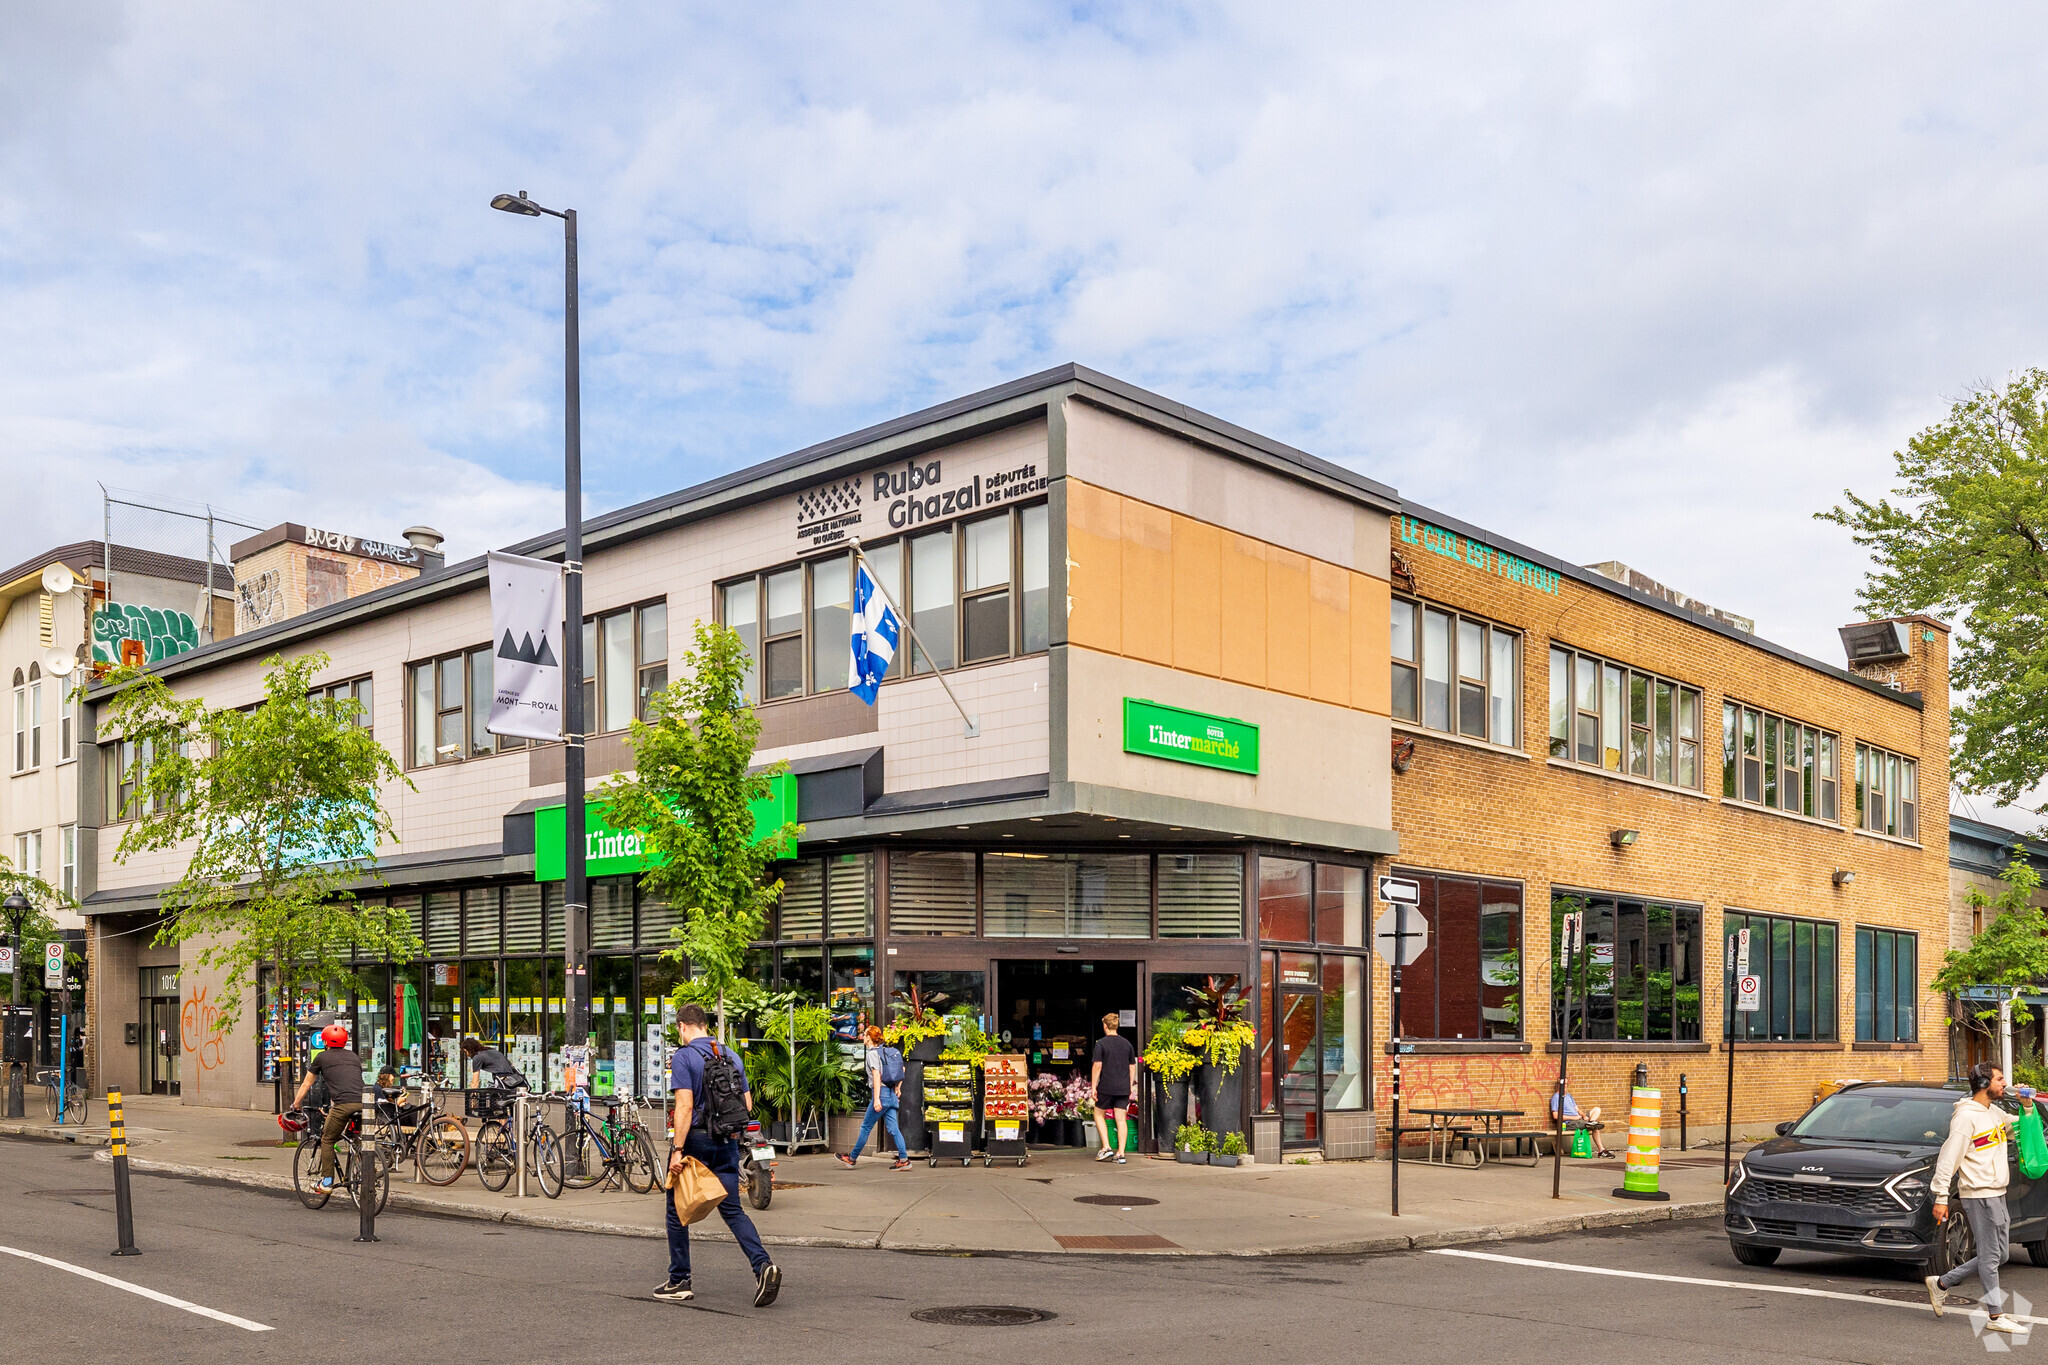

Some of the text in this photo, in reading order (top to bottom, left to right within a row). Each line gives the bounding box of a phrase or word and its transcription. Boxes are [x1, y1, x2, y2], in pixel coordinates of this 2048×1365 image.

[873, 461, 941, 501] Ruba
[985, 464, 1036, 489] DÉPUTÉE
[985, 476, 1049, 504] DE MERCIE
[888, 475, 981, 529] Ghazal
[797, 514, 862, 540] ASSEMBLÉE NATIONALE
[813, 530, 845, 545] DU QUÉBEC
[1400, 515, 1419, 545] LE
[1466, 538, 1493, 572] EST
[1498, 551, 1561, 596] PARTOUT
[1149, 725, 1240, 759] L'intermarché
[1206, 728, 1224, 738] BOYER
[161, 974, 177, 990] 1012
